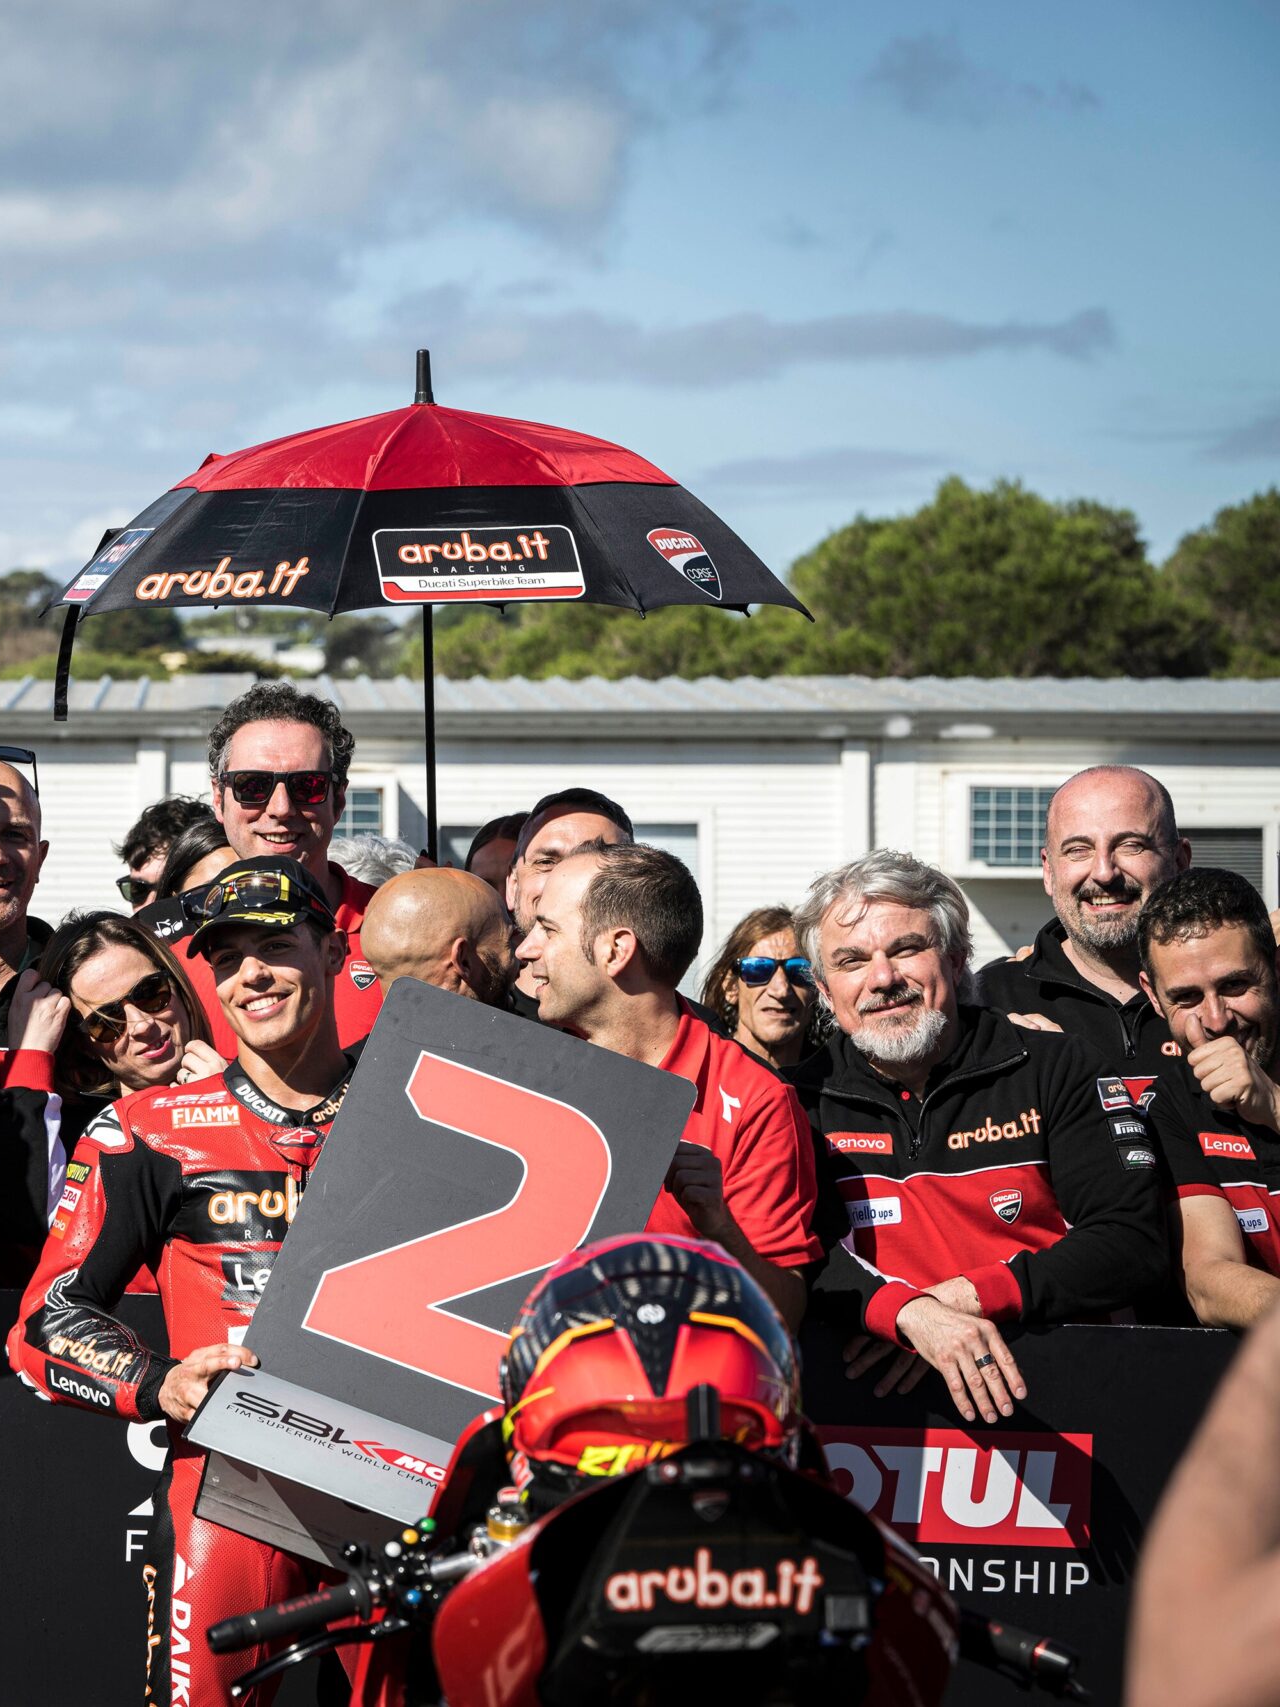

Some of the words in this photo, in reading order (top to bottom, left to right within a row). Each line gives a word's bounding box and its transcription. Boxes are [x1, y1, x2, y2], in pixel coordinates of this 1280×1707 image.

[398, 531, 550, 564] aruba.it
[655, 537, 698, 550] DUCATI
[135, 556, 310, 600] aruba.it
[432, 564, 526, 574] RACING
[686, 567, 716, 580] CORSE
[418, 578, 458, 589] Ducati
[458, 577, 515, 589] Superbike
[516, 576, 547, 586] Team
[172, 1105, 240, 1124] FIAMM
[235, 1083, 287, 1123] DUCATI
[947, 1108, 1041, 1150] aruba.it
[829, 1138, 886, 1150] Lenovo
[992, 1193, 1019, 1203] DUCATI
[301, 1050, 612, 1404] 2
[851, 1206, 876, 1222] riello
[877, 1208, 894, 1220] ups
[1247, 1217, 1262, 1229] ups
[48, 1335, 134, 1376] aruba.it
[49, 1368, 111, 1407] Lenovo
[226, 1404, 252, 1418] FIM
[257, 1416, 336, 1451] SUPERBIKE
[341, 1448, 392, 1472] WORLD
[606, 1547, 825, 1615] aruba.it
